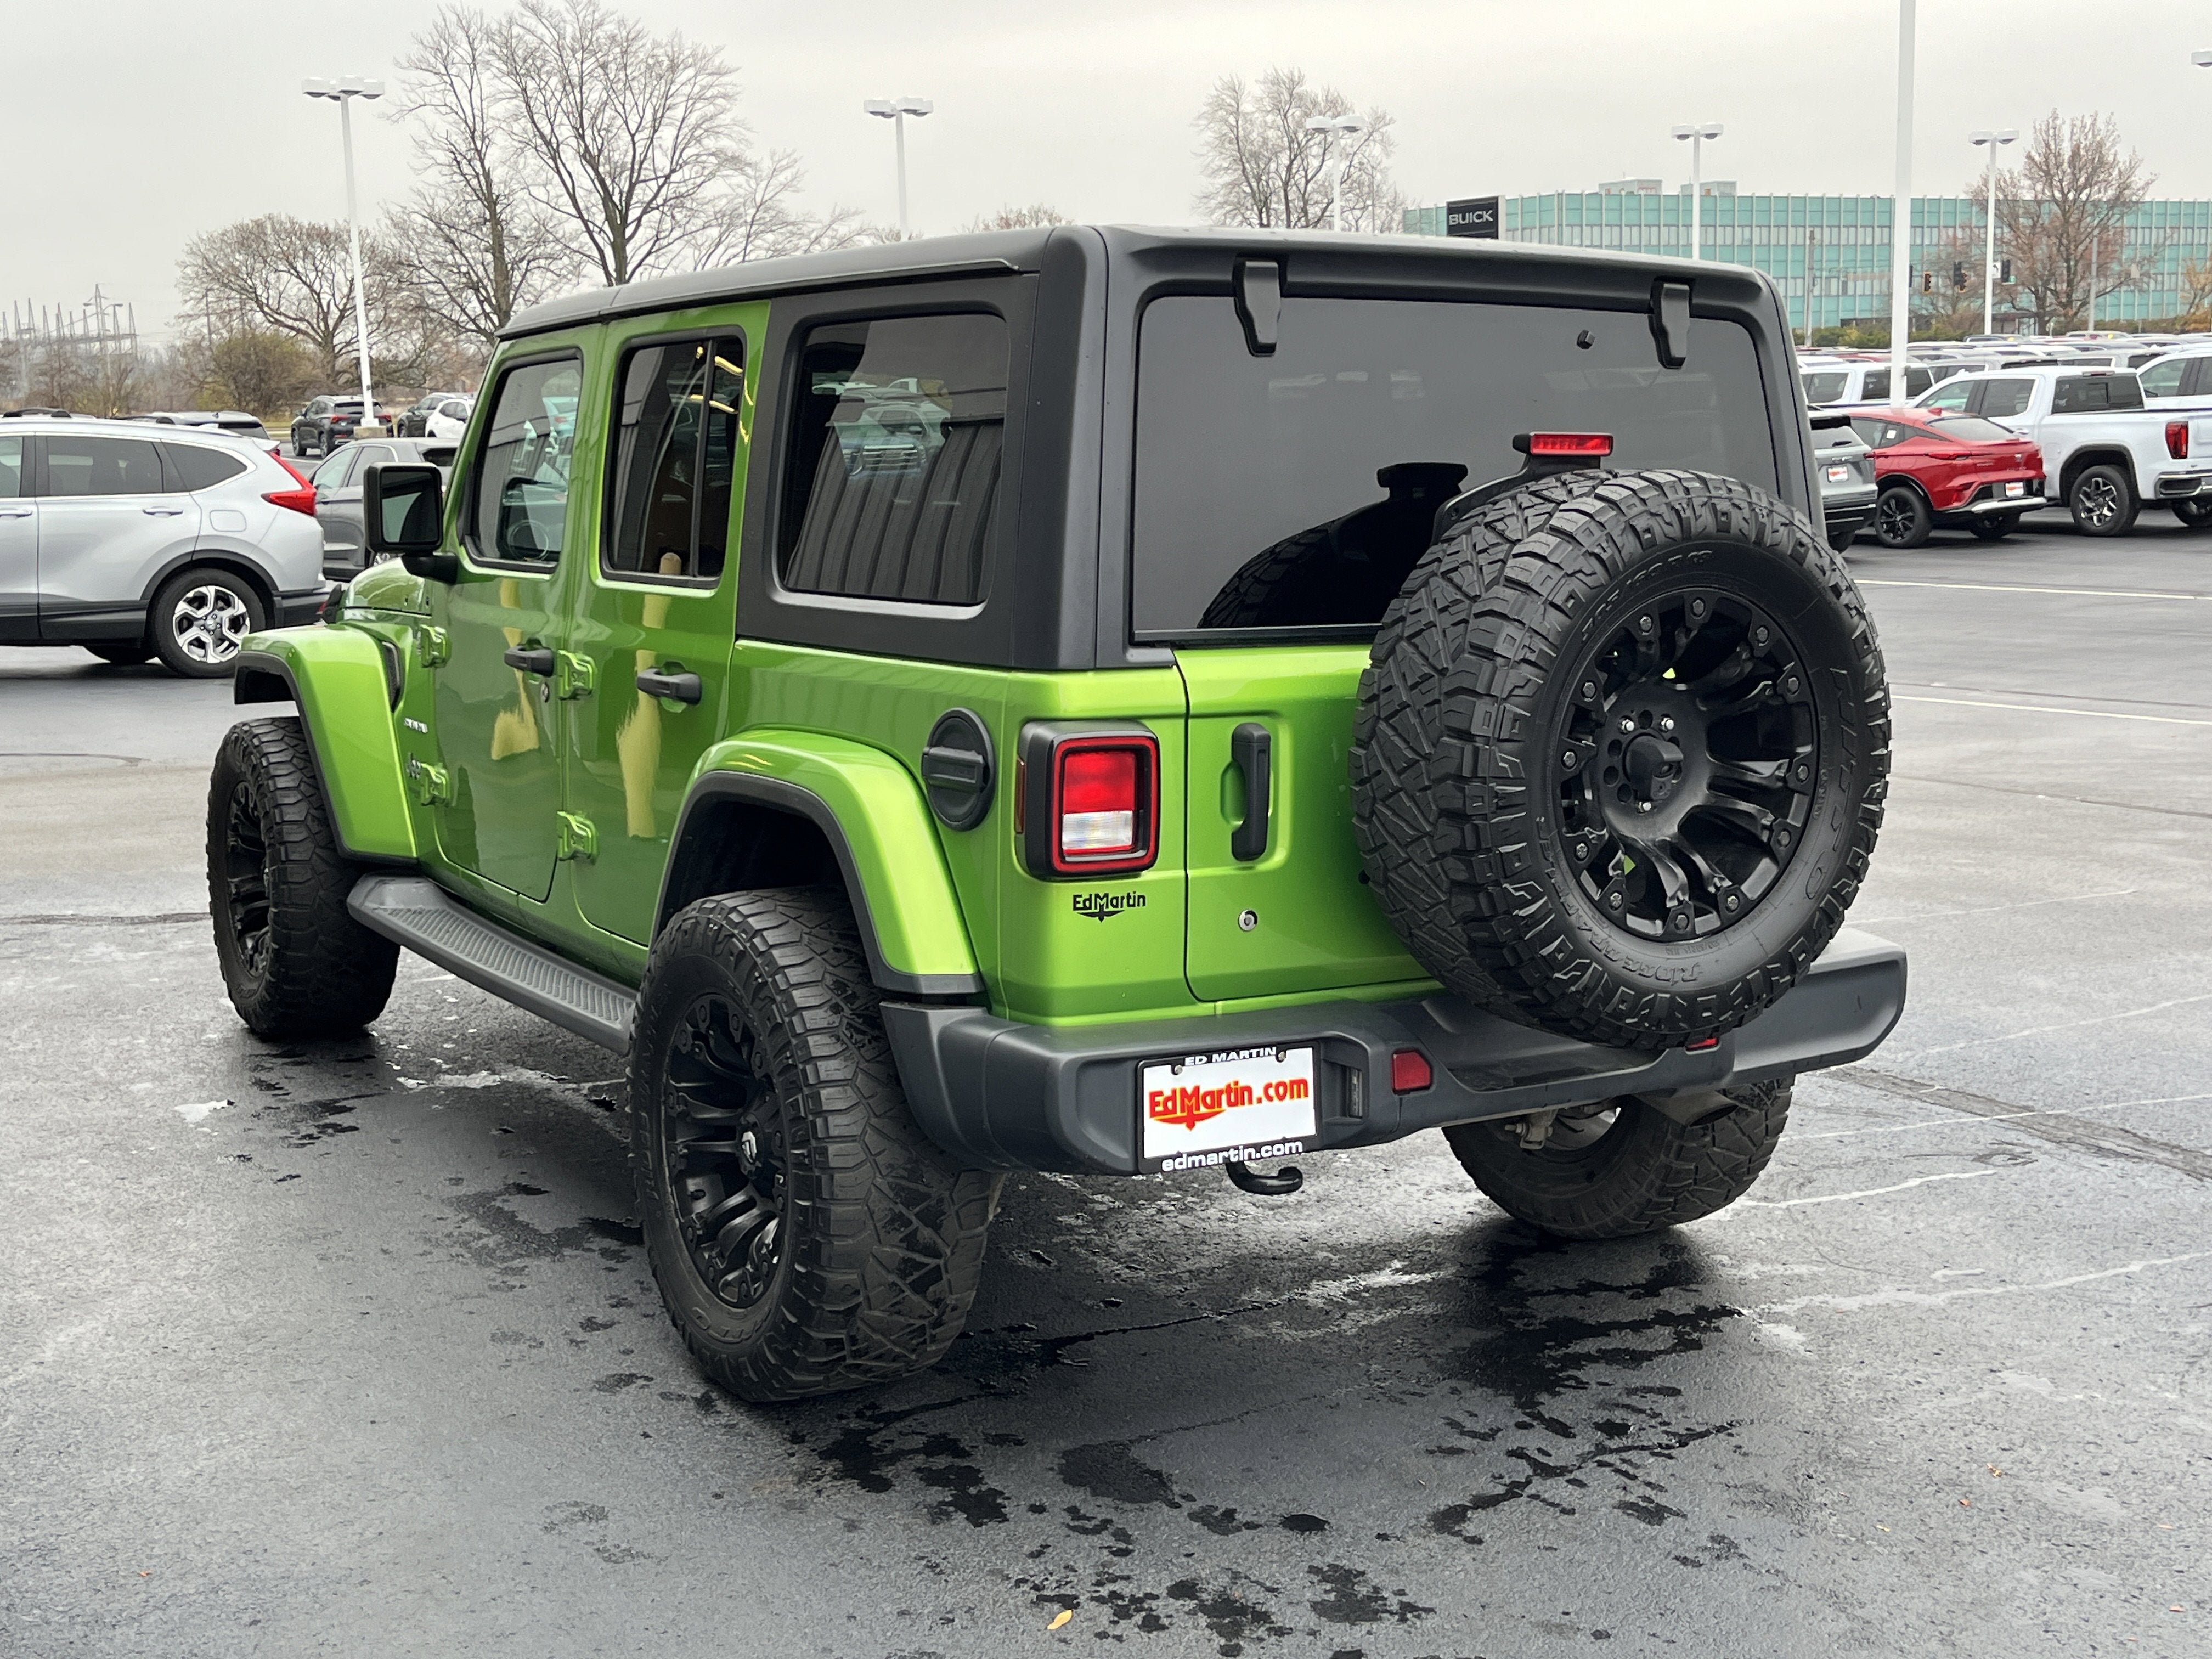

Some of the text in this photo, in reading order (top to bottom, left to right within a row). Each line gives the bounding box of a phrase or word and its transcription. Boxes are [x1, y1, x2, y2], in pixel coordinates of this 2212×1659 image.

[1449, 210, 1493, 225] BUICK
[1073, 891, 1146, 911] EdMartin
[1184, 1046, 1277, 1066] ED MARTIN
[1149, 1077, 1310, 1120] EdMartin.com
[1161, 1140, 1304, 1172] edmartin.com
